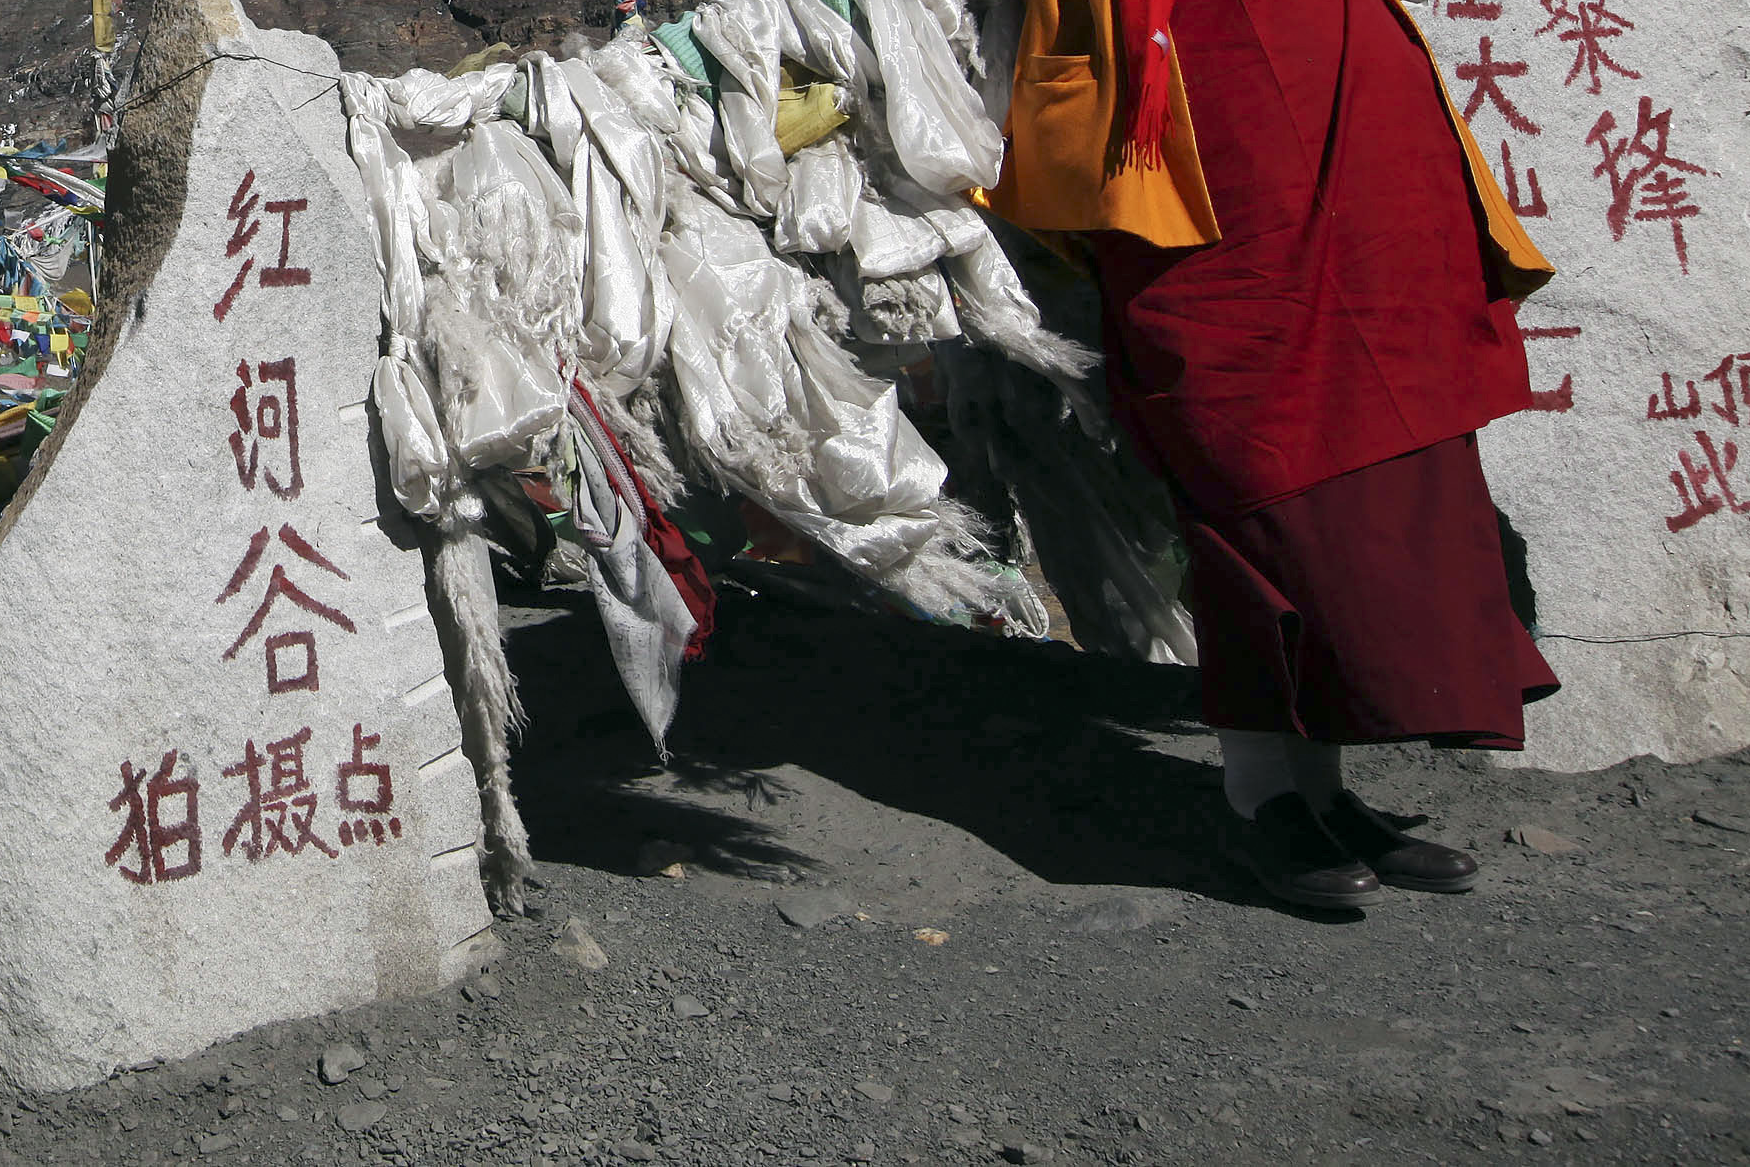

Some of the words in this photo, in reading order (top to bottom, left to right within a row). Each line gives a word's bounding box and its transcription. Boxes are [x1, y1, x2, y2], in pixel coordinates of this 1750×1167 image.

[214, 168, 356, 694] 红河谷
[105, 722, 402, 885] 拍摄点
